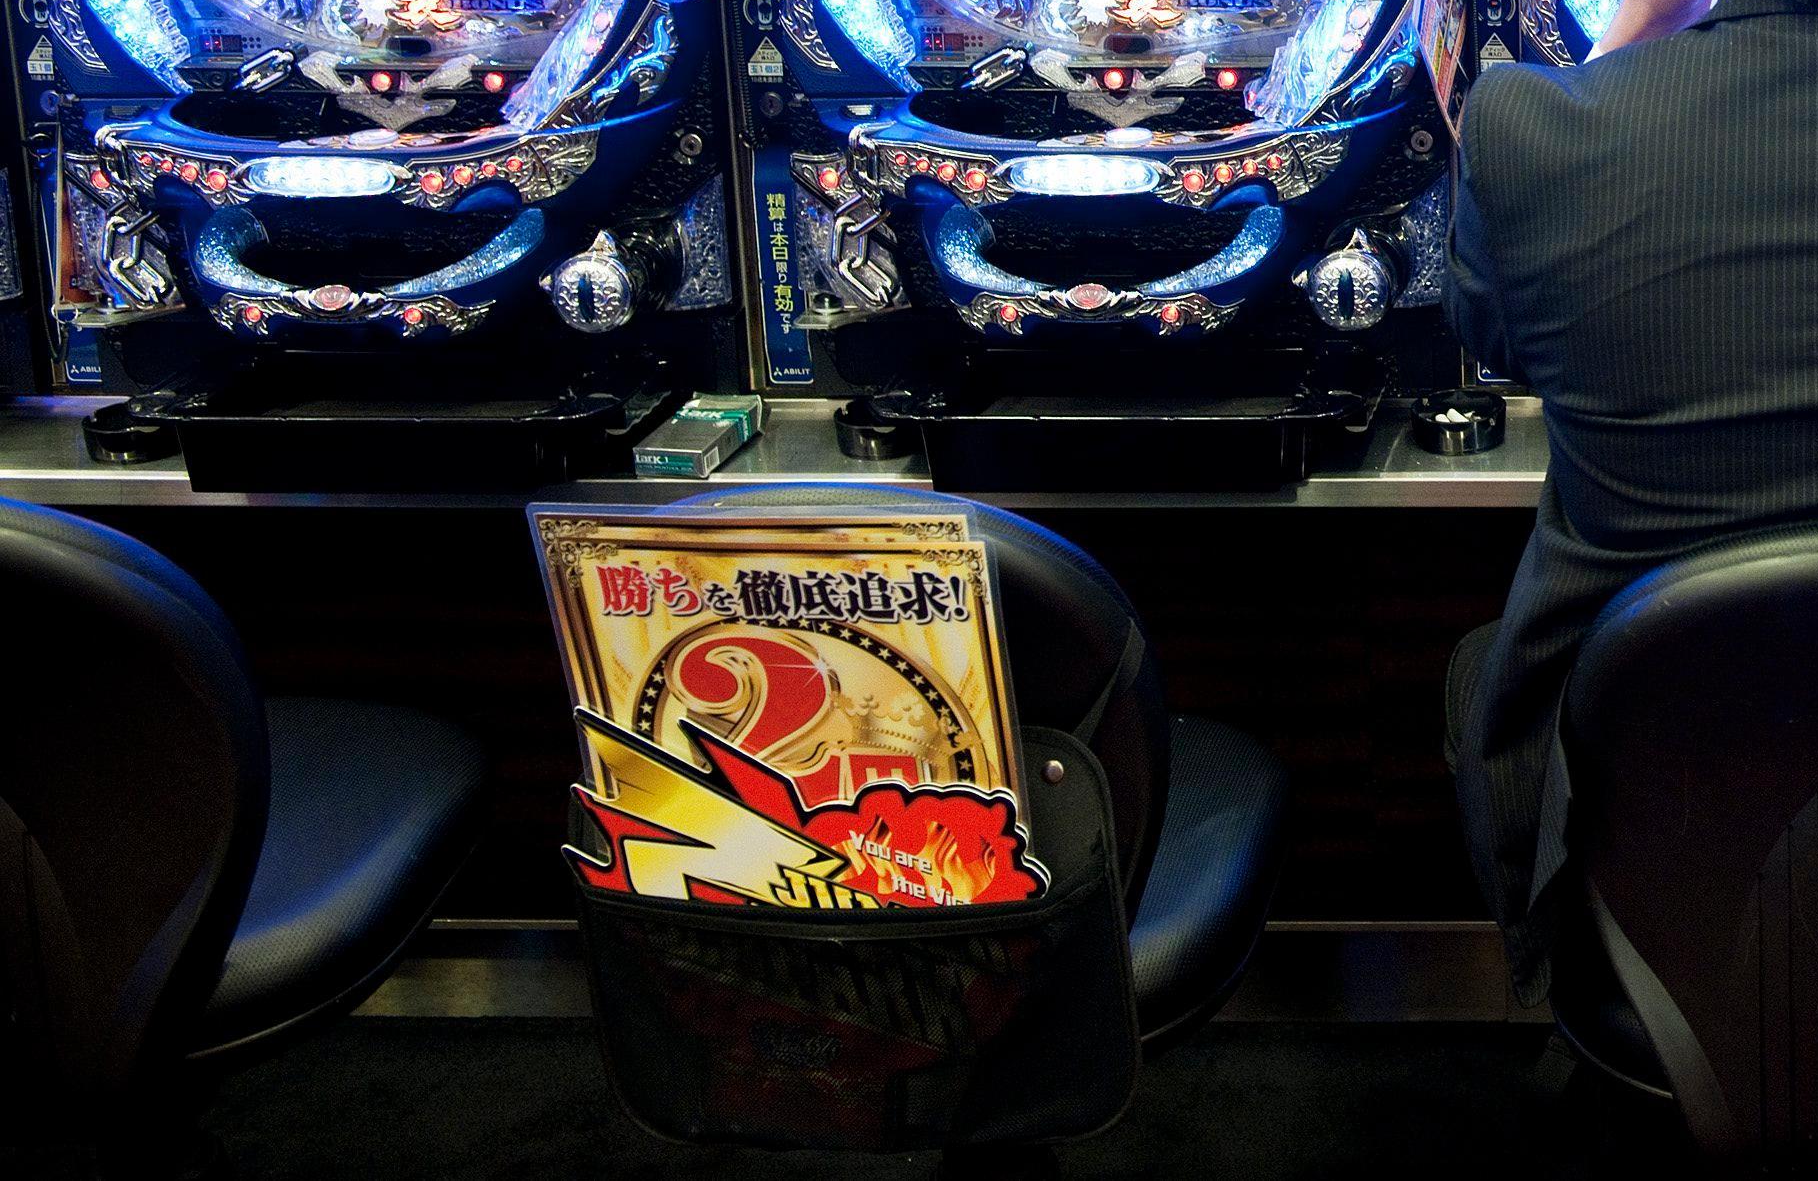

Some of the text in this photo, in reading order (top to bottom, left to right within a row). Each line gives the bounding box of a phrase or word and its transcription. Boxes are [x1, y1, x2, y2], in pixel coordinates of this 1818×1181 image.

[766, 193, 794, 334] 精算は本日限り有効です
[598, 565, 970, 621] 勝ちを徹底追求!
[848, 830, 934, 875] You are
[891, 874, 927, 896] the
